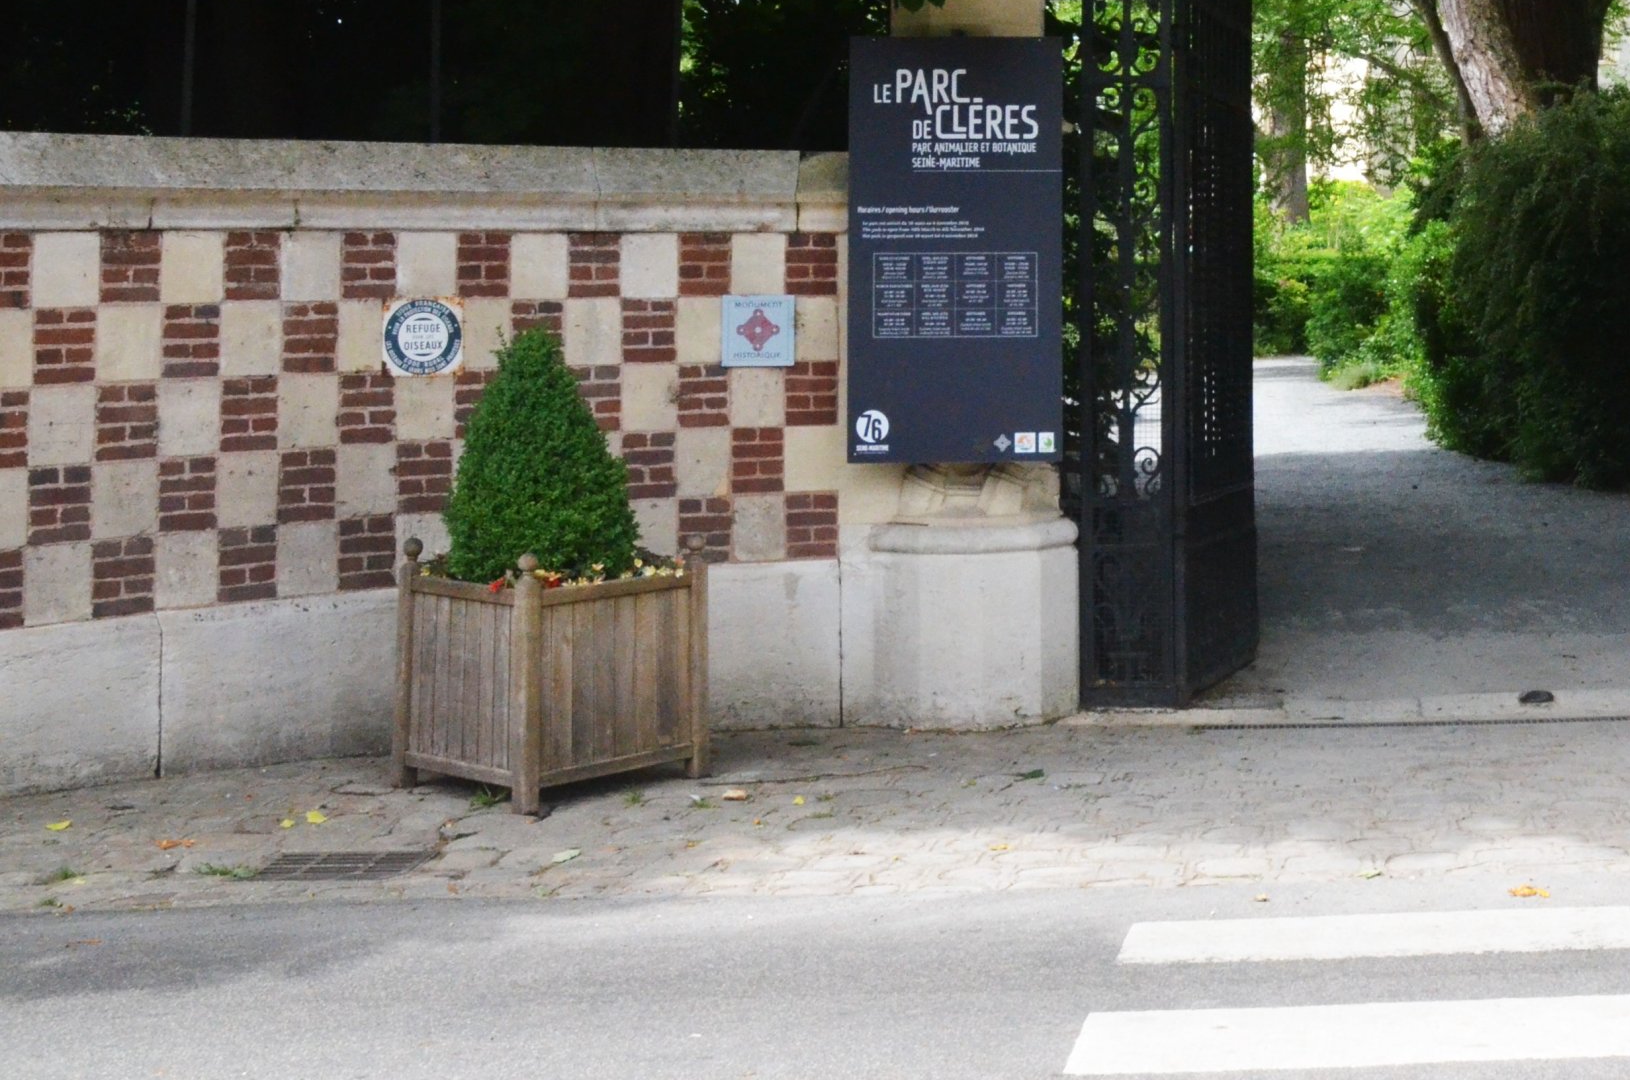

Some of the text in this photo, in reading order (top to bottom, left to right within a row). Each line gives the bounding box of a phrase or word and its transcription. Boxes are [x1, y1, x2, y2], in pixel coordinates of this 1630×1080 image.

[873, 68, 971, 116] LE PARC
[912, 119, 932, 140] DE
[912, 141, 1037, 156] PARC ANIMALIER ET BOTANIQUE
[912, 154, 981, 171] SEINE-MARITIME
[406, 324, 441, 334] REFUGE
[403, 341, 443, 350] OISEAUX
[859, 414, 883, 443] 76
